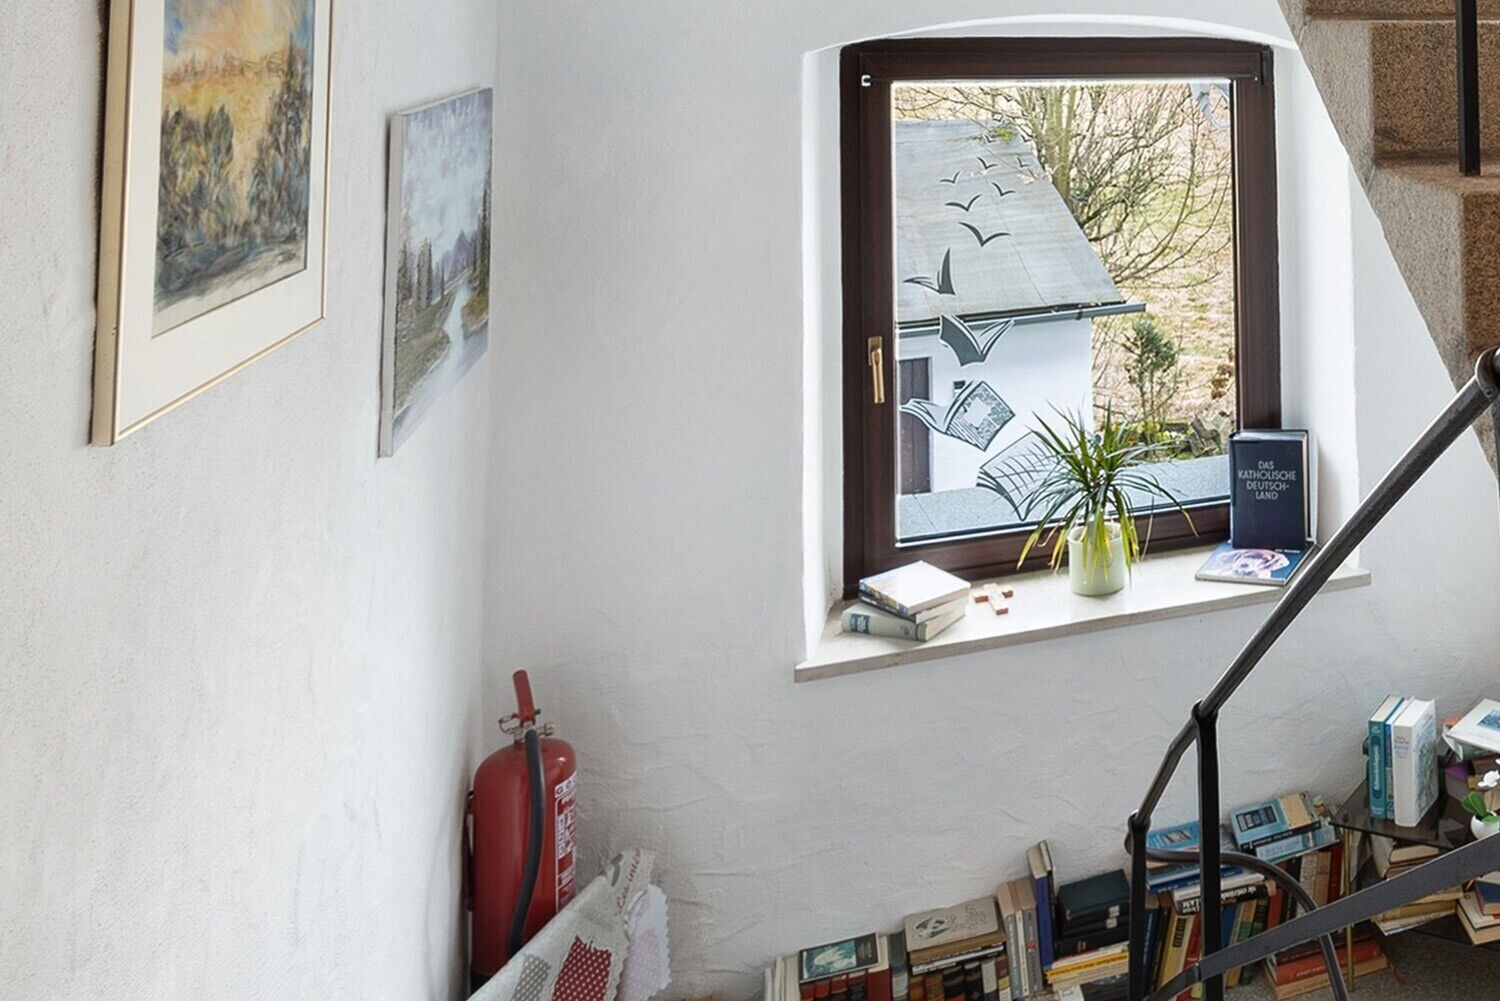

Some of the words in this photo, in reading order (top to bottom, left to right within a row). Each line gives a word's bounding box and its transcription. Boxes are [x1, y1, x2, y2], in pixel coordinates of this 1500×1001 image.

[1258, 460, 1275, 470] DAS
[1239, 470, 1297, 480] KATHOLISCHE
[1246, 480, 1290, 490] DEUTSCH-
[1255, 491, 1279, 500] LAND
